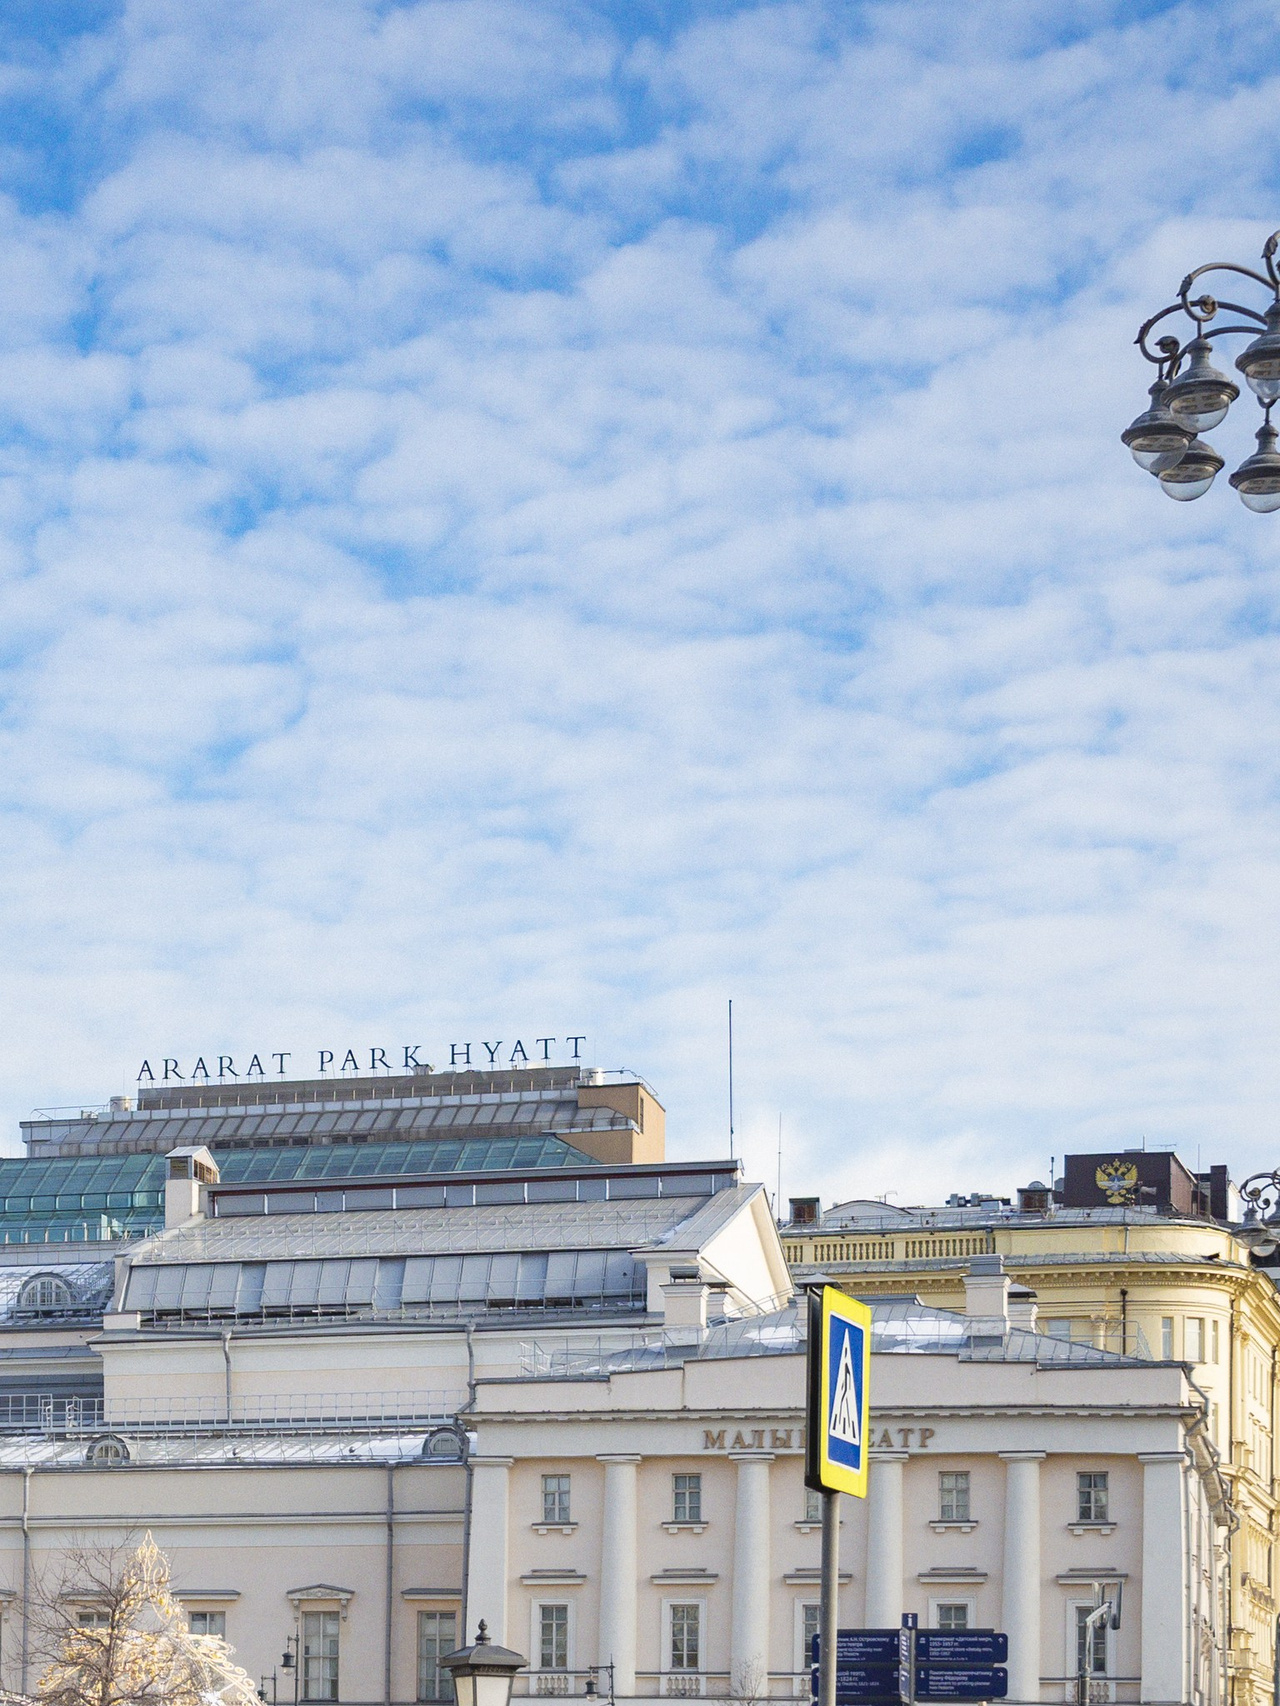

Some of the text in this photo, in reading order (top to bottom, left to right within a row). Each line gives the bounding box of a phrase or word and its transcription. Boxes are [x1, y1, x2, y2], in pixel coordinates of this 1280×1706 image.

[135, 1036, 587, 1081] ARARAT PARK HYATT
